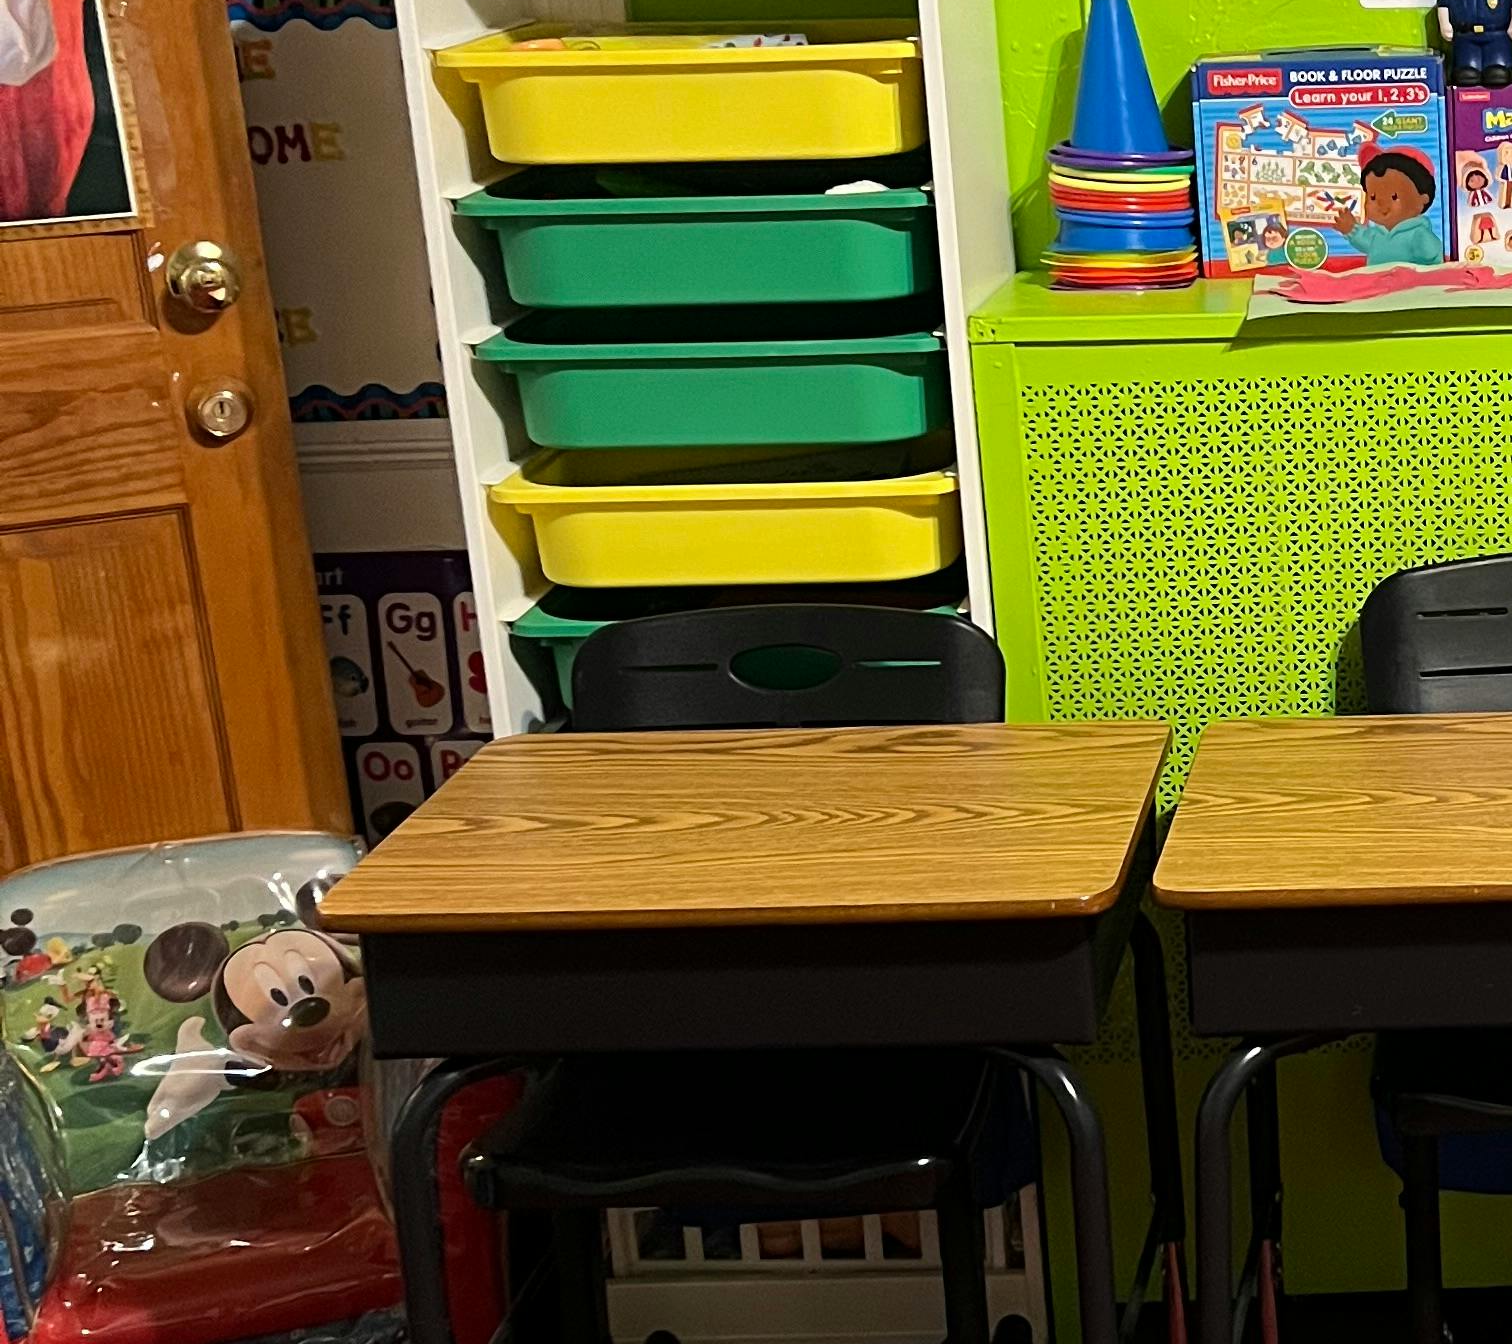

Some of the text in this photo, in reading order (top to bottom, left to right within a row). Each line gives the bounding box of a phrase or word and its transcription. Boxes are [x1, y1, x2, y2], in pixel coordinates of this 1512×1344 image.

[1213, 73, 1277, 87] Fisher-Price
[1289, 67, 1428, 83] BOOK & FLOOR PUZZLE
[1294, 91, 1339, 104] Learn
[1341, 91, 1372, 105] your
[1406, 87, 1425, 100] 3's
[385, 602, 437, 642] Gg
[362, 751, 415, 782] Oo
